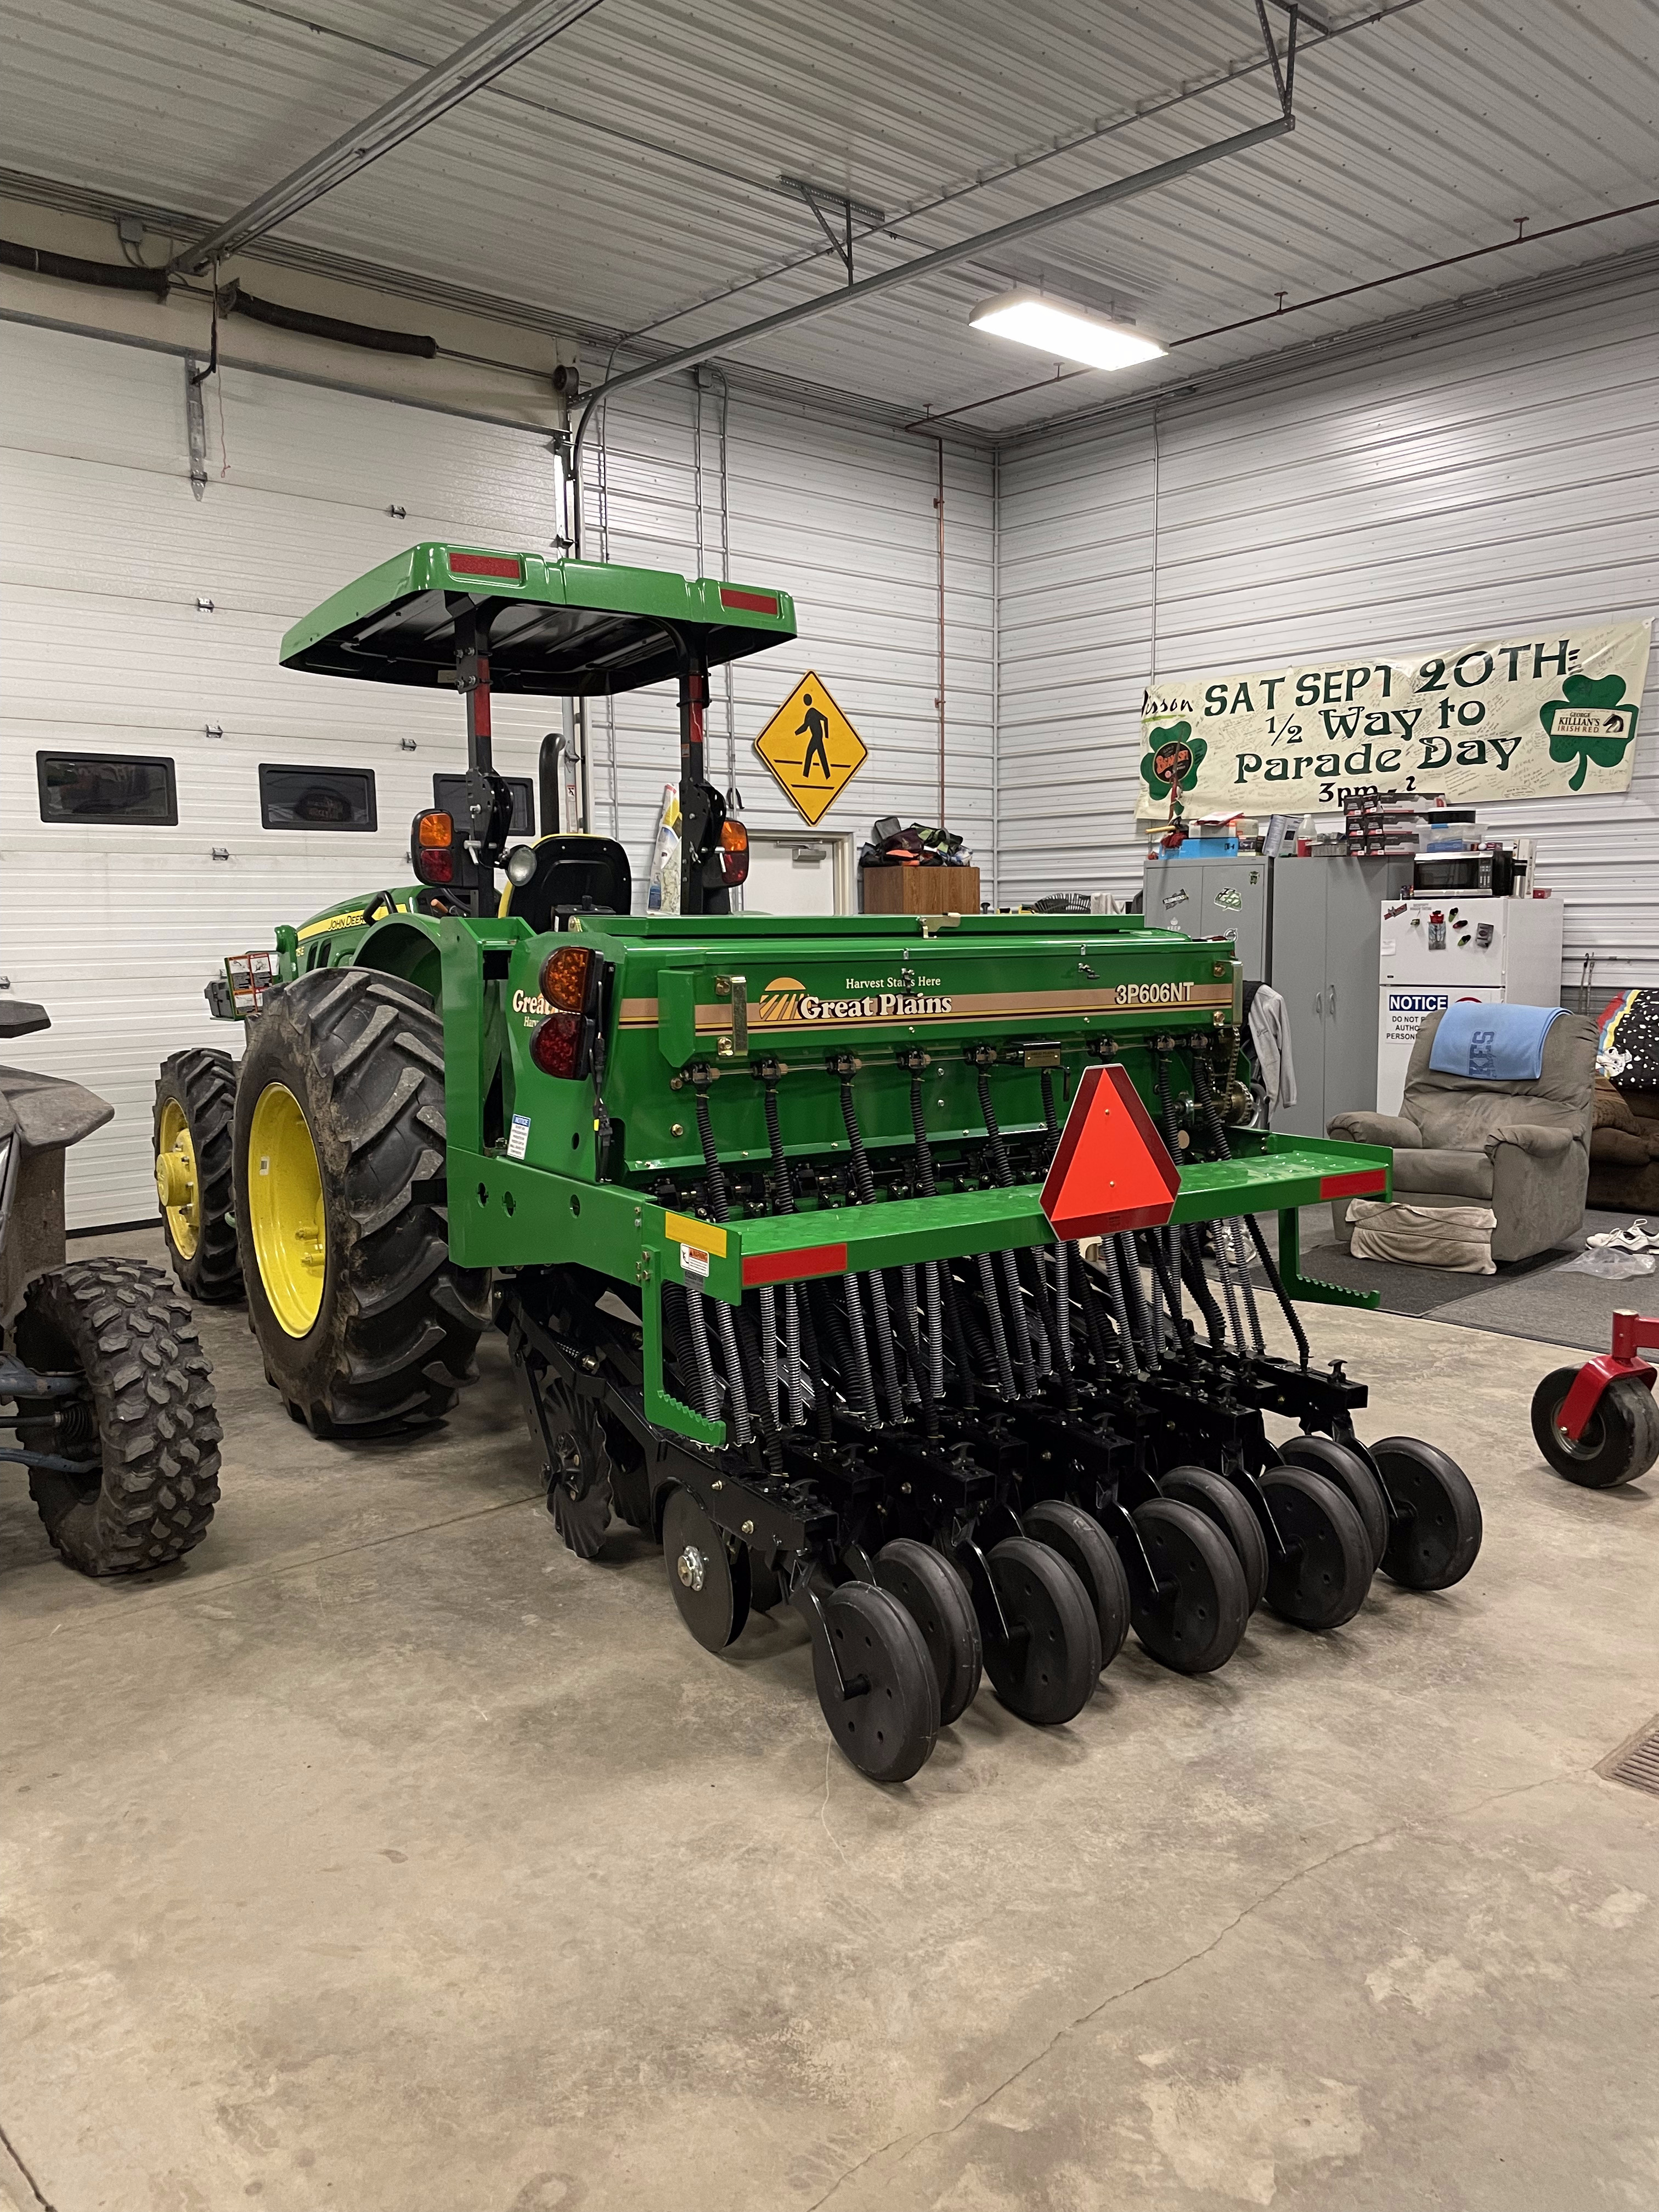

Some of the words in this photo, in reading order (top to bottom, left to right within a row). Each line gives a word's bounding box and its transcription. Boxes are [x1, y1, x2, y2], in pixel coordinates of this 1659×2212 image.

[1204, 676, 1286, 716] SAT
[1295, 665, 1392, 707] SEPT
[1414, 639, 1570, 694] 20TH
[1318, 707, 1423, 741] Way
[1438, 697, 1486, 729] to
[1559, 717, 1600, 726] KILLIAN'S
[1234, 743, 1401, 784] Parade
[1417, 736, 1522, 771] Day
[1318, 782, 1378, 807] 3pm
[328, 919, 345, 930] JOHN
[346, 915, 364, 926] DEER
[846, 978, 884, 989] Harvest
[918, 976, 941, 986] Here
[1115, 981, 1194, 1005] 3P606NT
[800, 996, 874, 1020] Great
[878, 994, 952, 1015] Plains
[1390, 996, 1447, 1011] NOTICE
